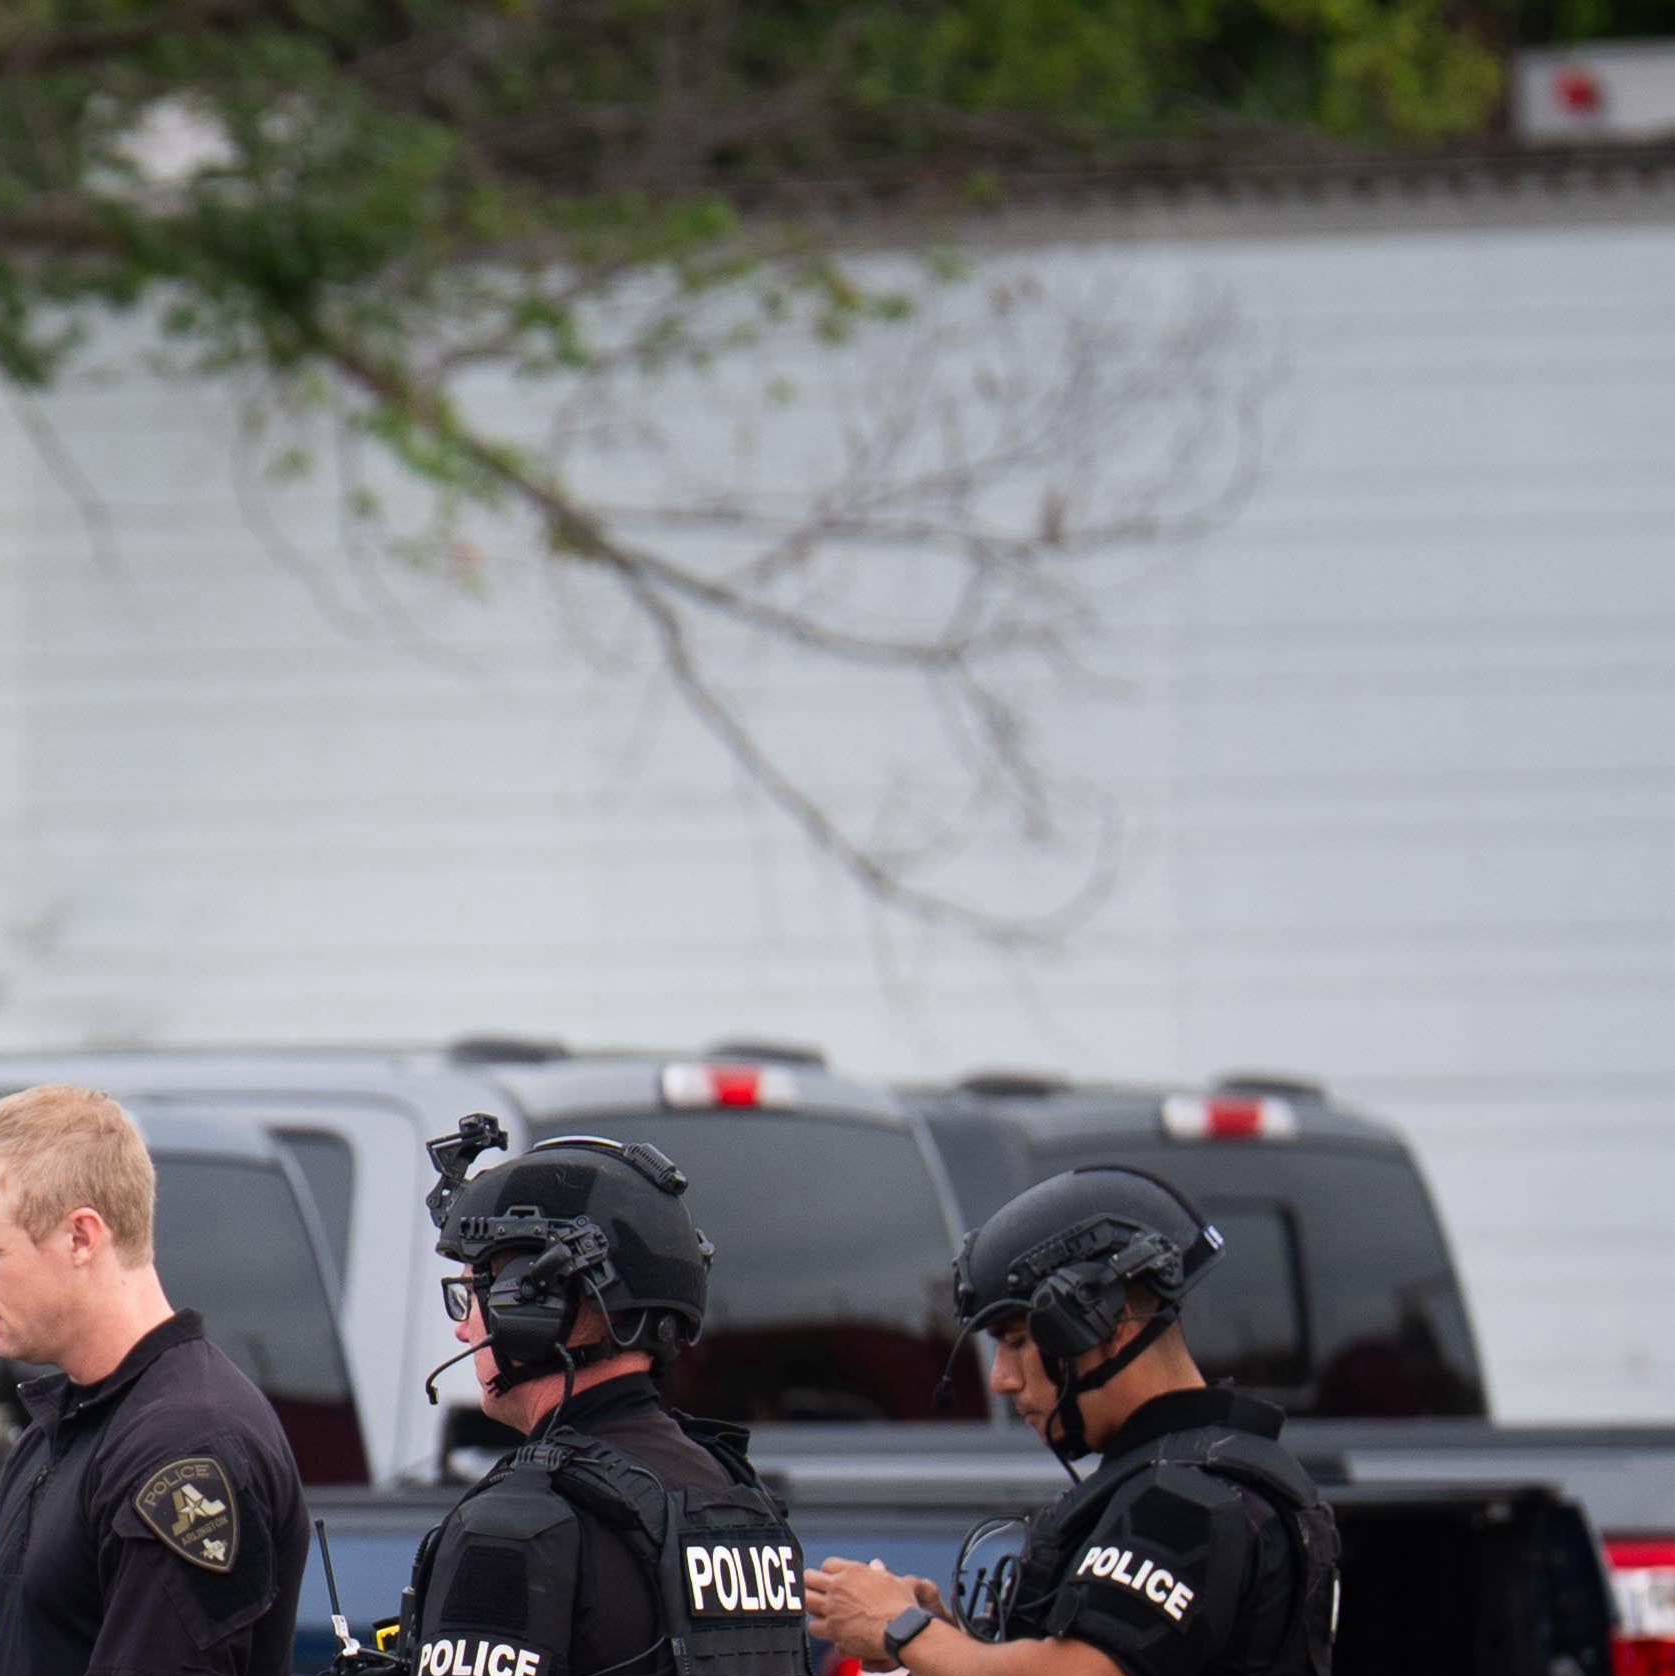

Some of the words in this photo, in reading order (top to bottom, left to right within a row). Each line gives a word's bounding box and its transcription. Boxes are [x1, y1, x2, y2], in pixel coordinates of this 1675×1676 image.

[144, 1464, 211, 1508] POLICE
[686, 1545, 802, 1612] POLICE
[1076, 1546, 1194, 1621] POLICE
